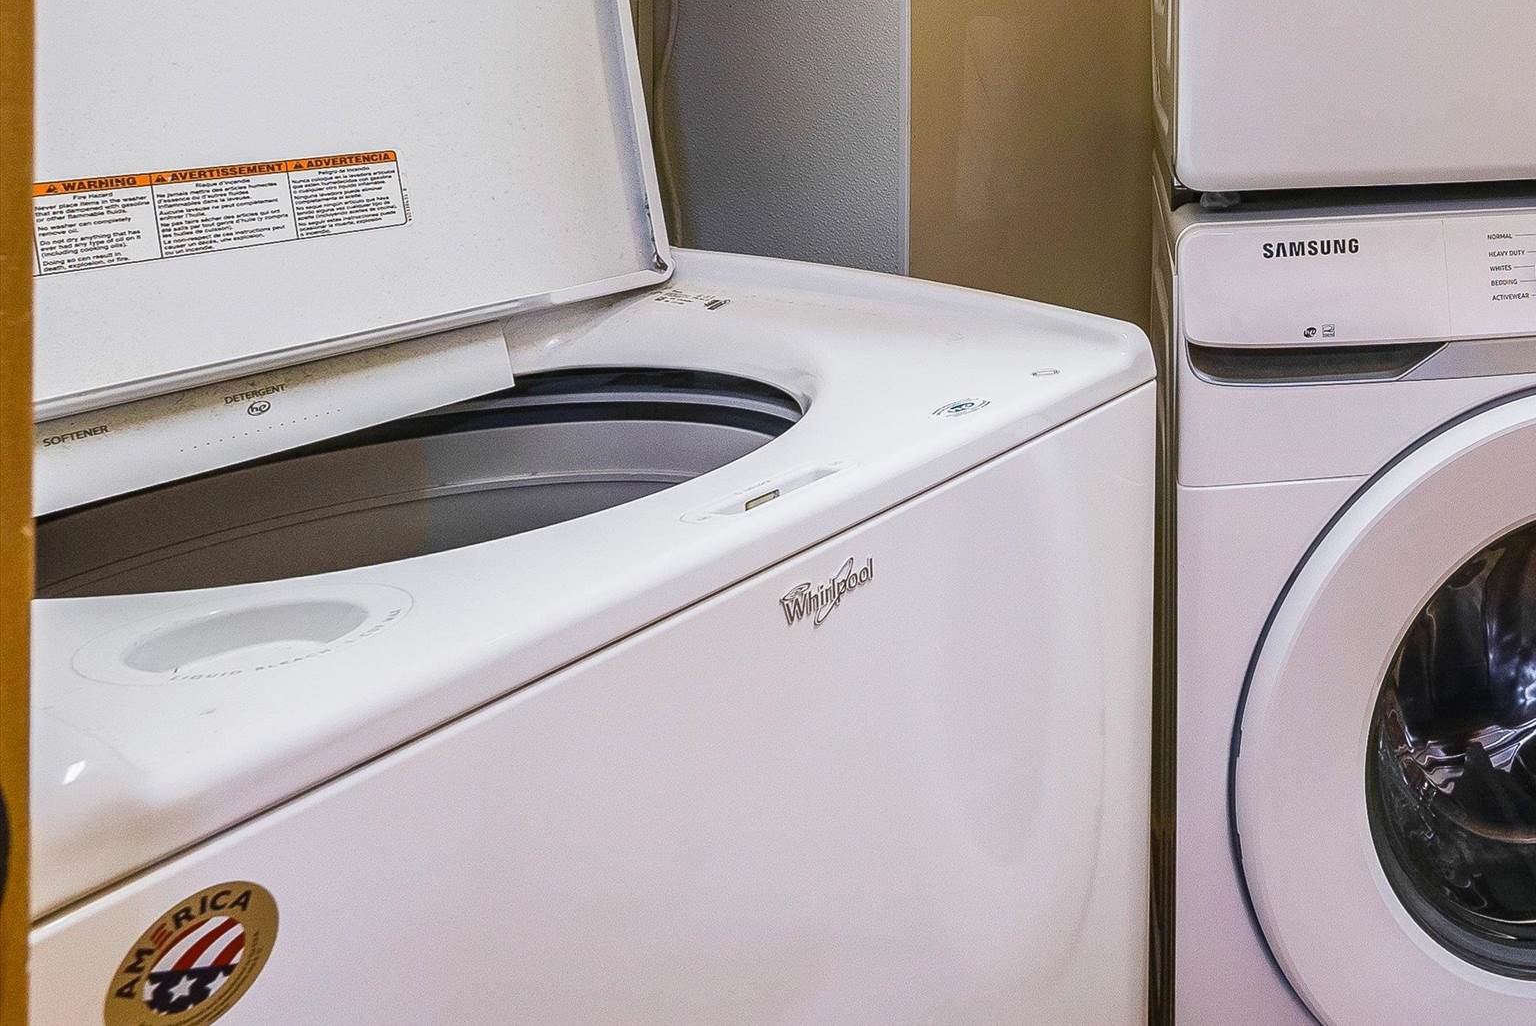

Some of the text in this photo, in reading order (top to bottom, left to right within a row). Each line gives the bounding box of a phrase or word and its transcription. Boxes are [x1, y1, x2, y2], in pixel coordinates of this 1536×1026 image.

[307, 153, 391, 168] ADVERTENCIA
[170, 163, 286, 181] AVERTISSEMENT
[62, 177, 137, 191] WARNING
[1262, 238, 1360, 259] SAMSUNG
[224, 383, 286, 405] DETERGENT
[43, 425, 109, 447] SOFTENER
[780, 557, 873, 628] Whirlpool
[115, 889, 252, 999] AMERICA
